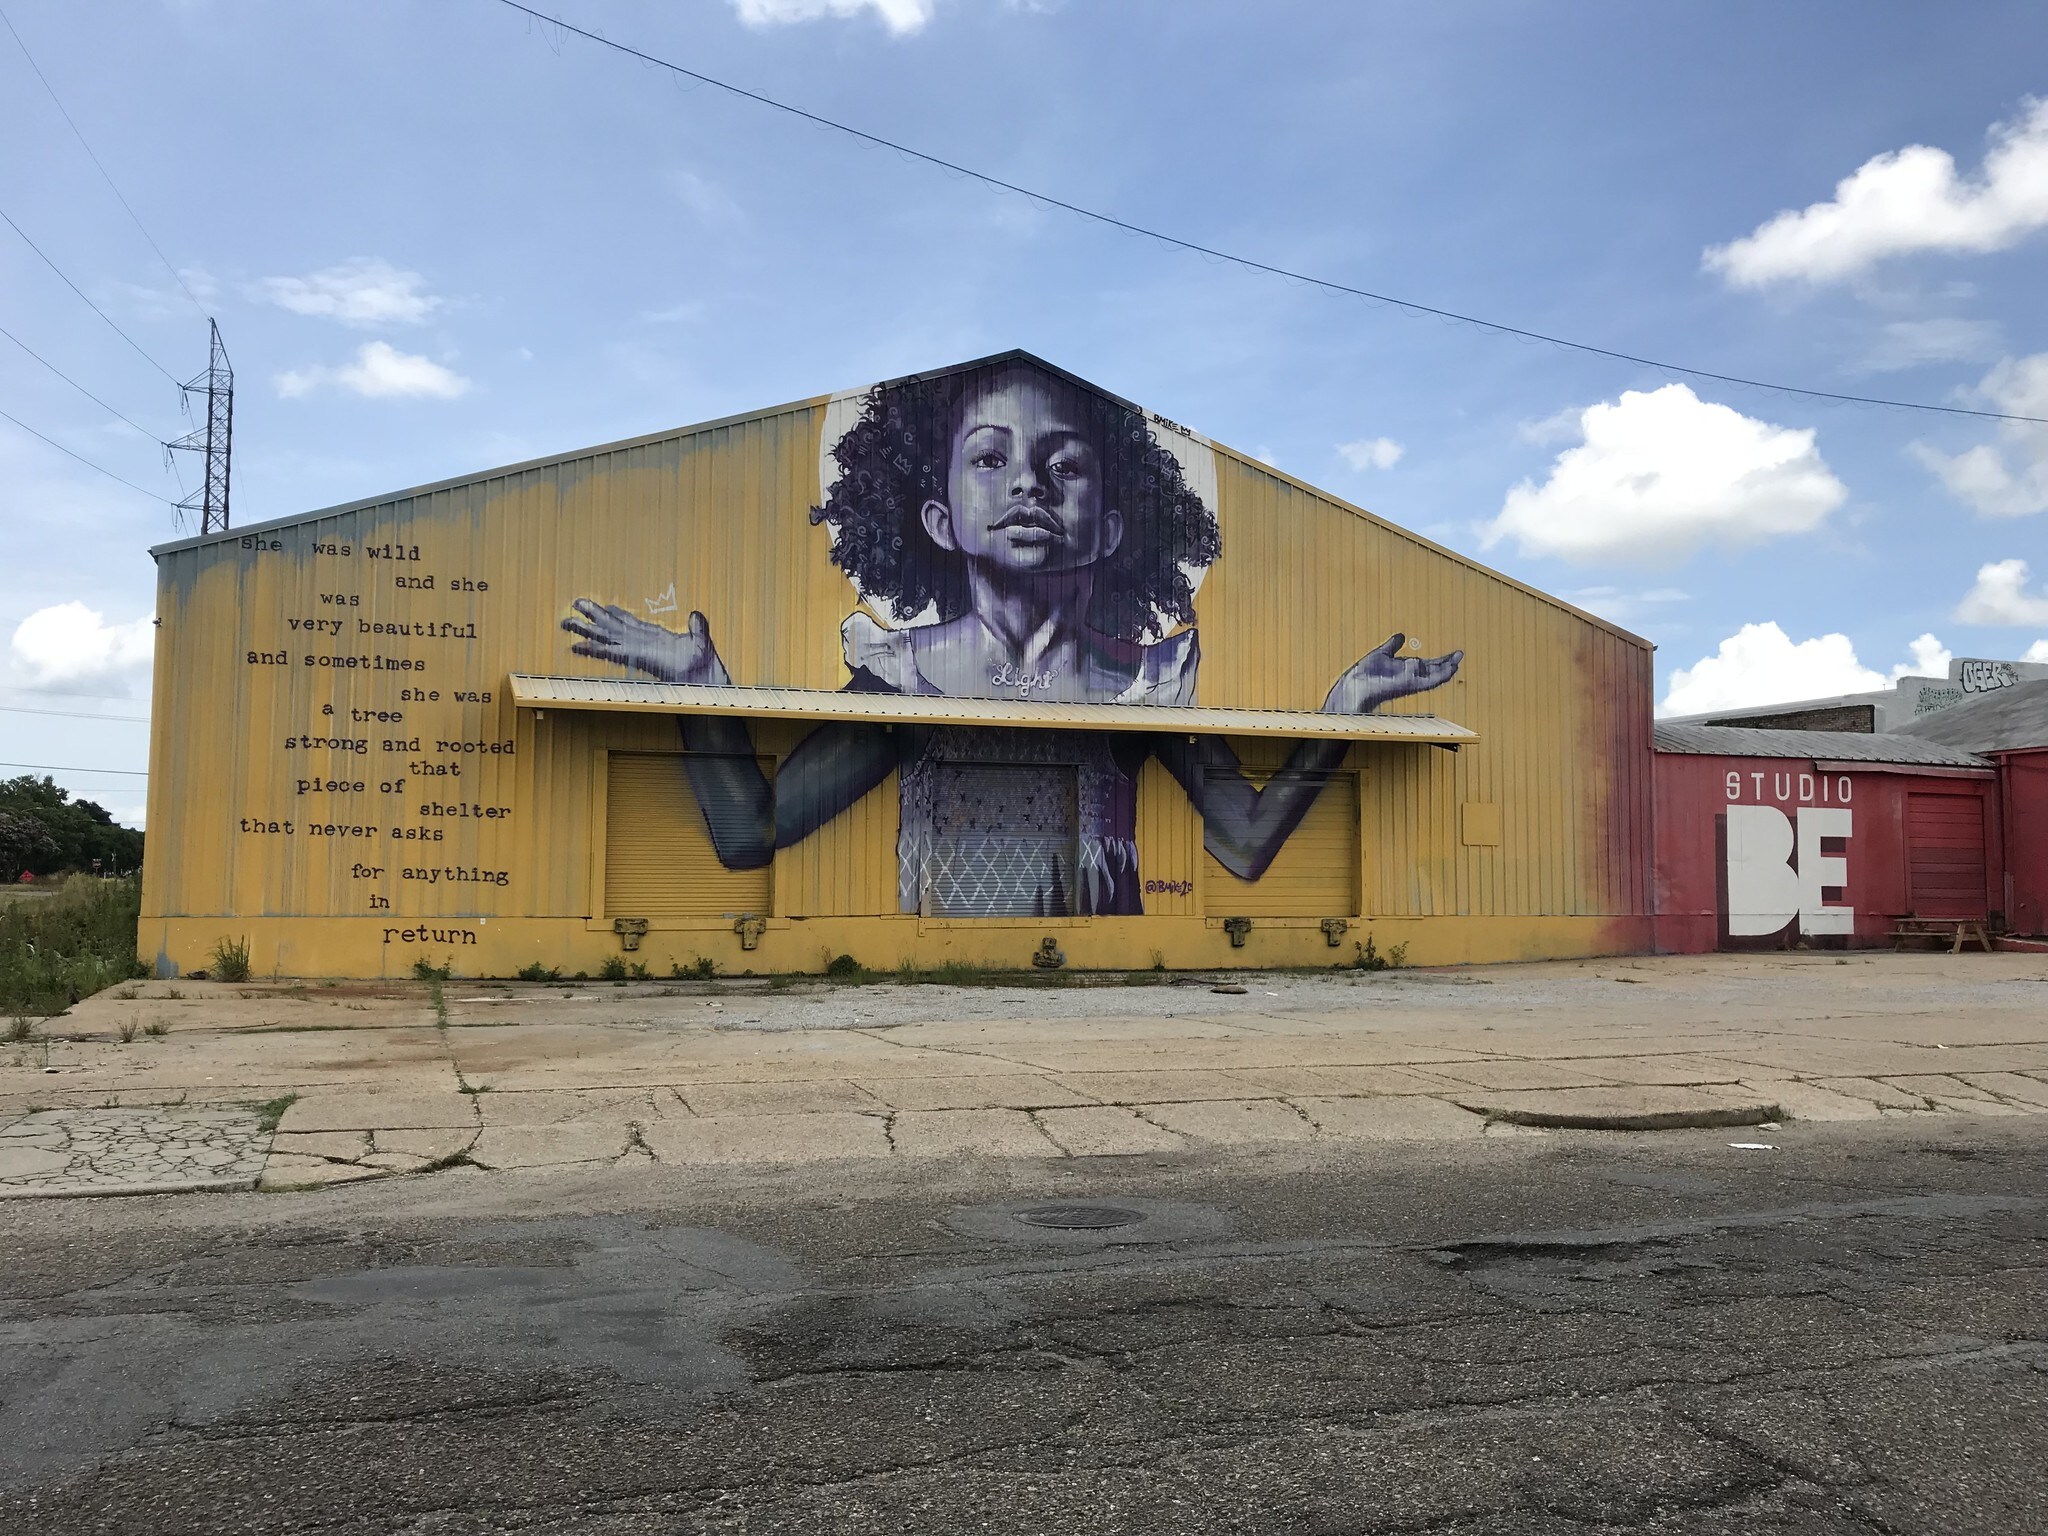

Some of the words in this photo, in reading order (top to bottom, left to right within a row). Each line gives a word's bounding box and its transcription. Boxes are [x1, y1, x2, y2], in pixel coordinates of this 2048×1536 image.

[241, 536, 283, 553] she
[311, 541, 352, 557] was
[365, 543, 421, 562] wild
[395, 574, 435, 590] and
[450, 576, 489, 593] she
[319, 592, 360, 607] was
[287, 617, 344, 637] very
[358, 618, 478, 639] beautiful
[246, 650, 289, 666] and
[304, 654, 425, 672] sometimes
[992, 662, 1053, 697] Light
[400, 687, 440, 702] she
[453, 691, 492, 704] was
[321, 703, 335, 716] a
[350, 707, 404, 723] tree
[284, 734, 369, 755] strong
[382, 737, 421, 753] and
[435, 738, 515, 755] rooted
[408, 760, 462, 777] that
[296, 777, 365, 796] piece
[379, 778, 406, 795] of
[1726, 771, 1853, 803] STUDIO
[419, 801, 512, 819] shelter
[239, 818, 295, 835] that
[308, 822, 378, 838] never
[391, 825, 444, 842] asks
[351, 863, 385, 880] for
[401, 866, 510, 887] anything
[1726, 804, 1855, 936] BE
[368, 893, 391, 910] in
[382, 923, 478, 945] return
